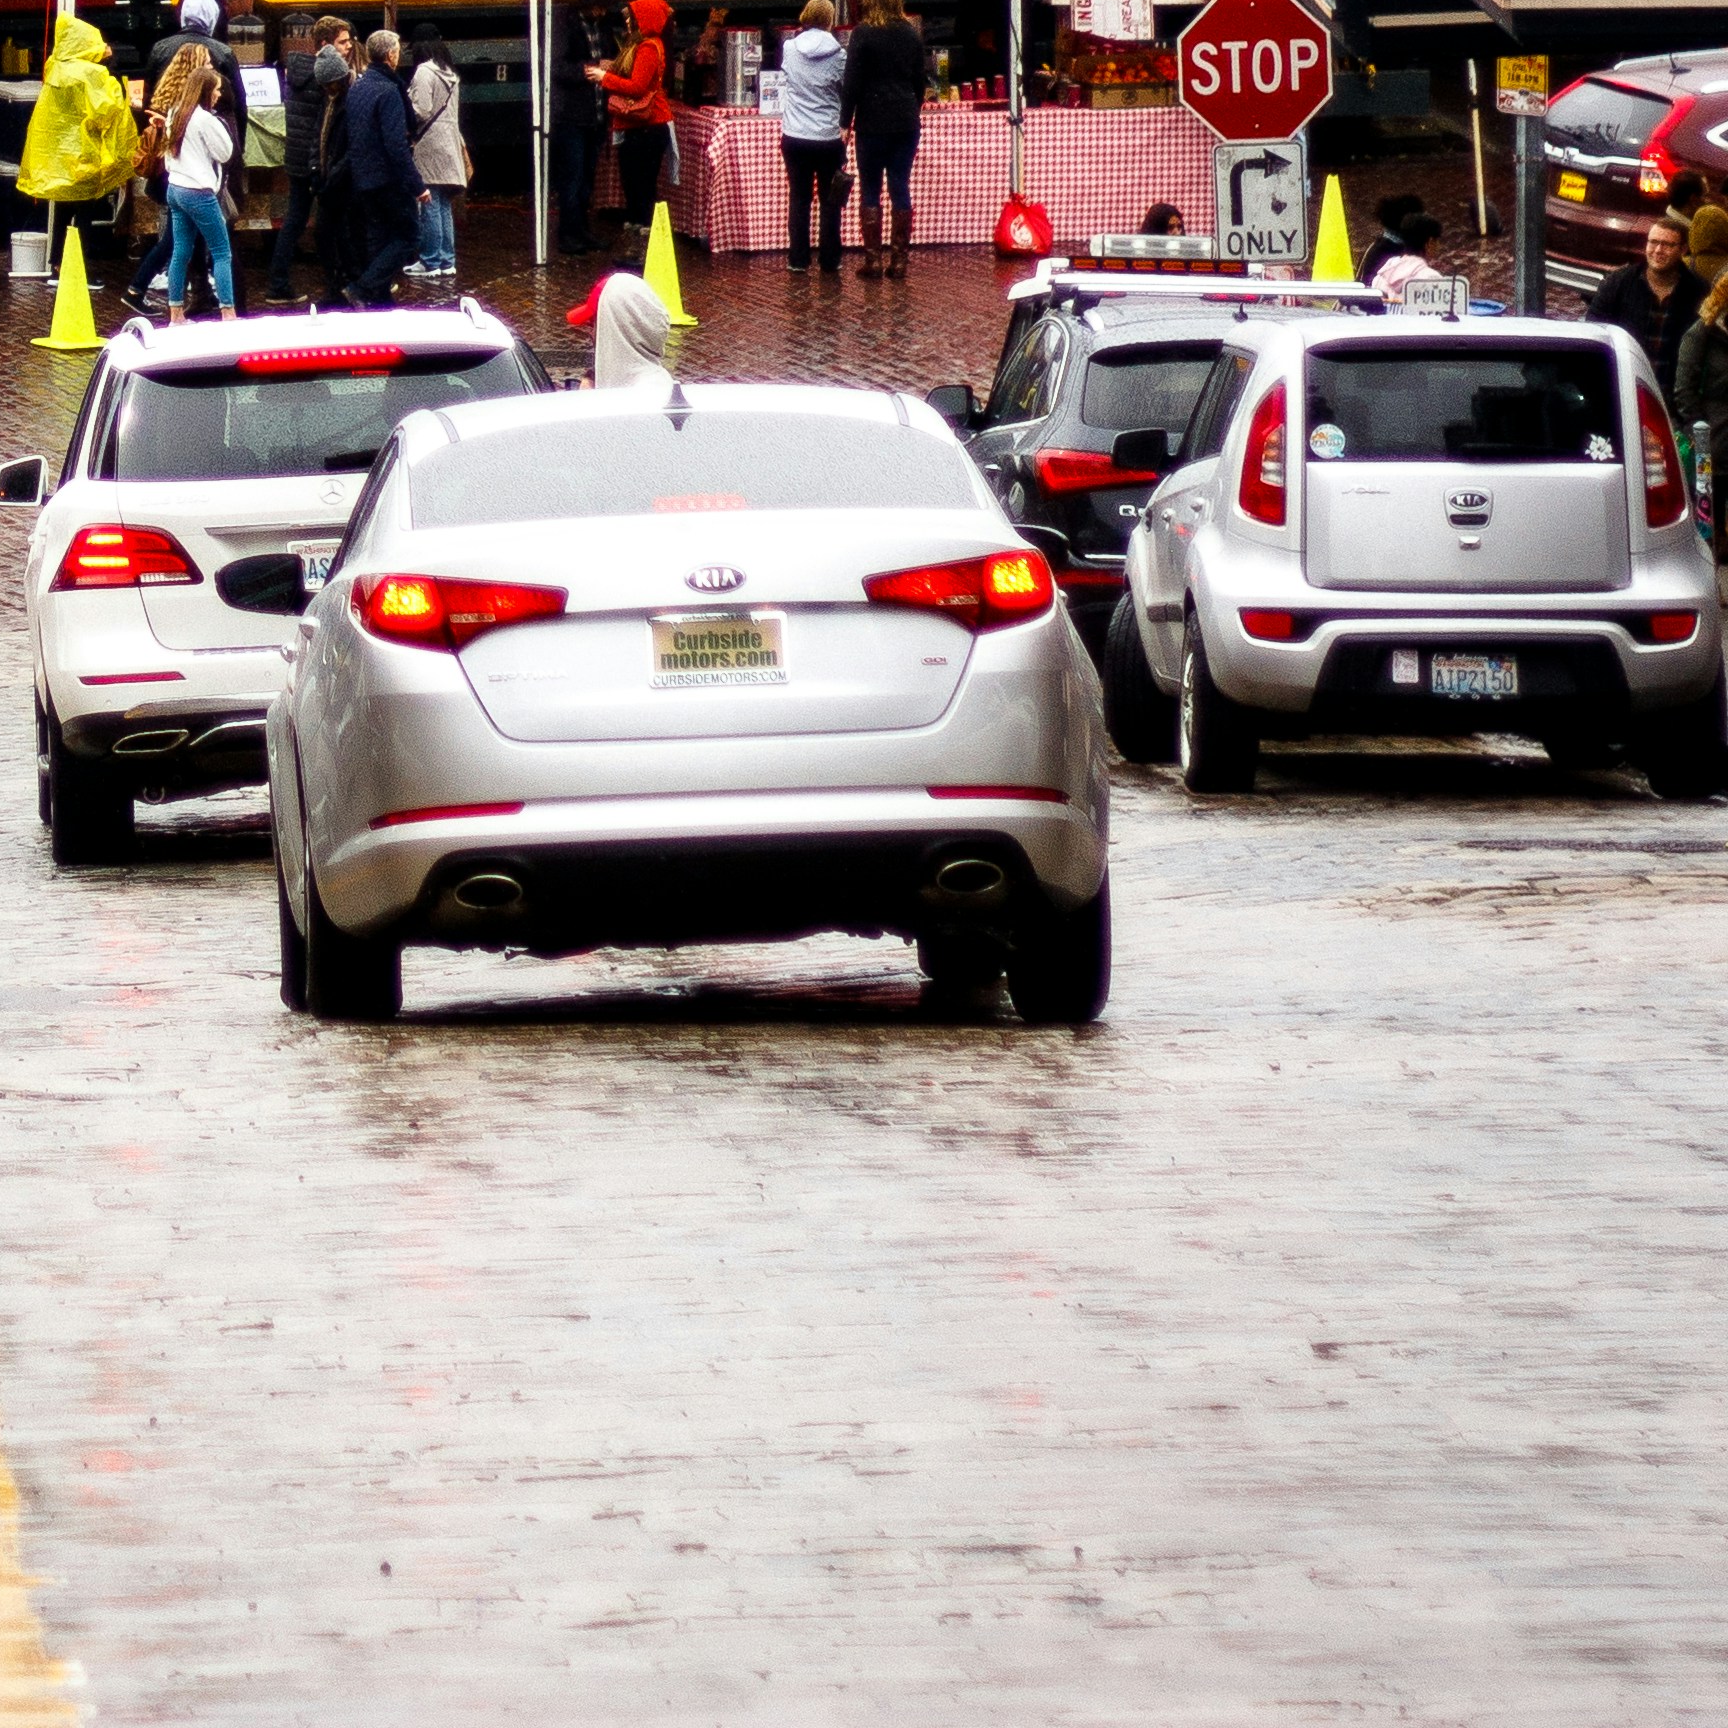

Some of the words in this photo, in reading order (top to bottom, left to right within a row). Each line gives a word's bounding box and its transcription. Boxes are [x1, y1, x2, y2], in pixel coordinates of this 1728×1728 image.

[1190, 38, 1319, 96] STOP
[248, 79, 263, 87] HOT
[1227, 229, 1298, 257] ONLY
[1413, 287, 1457, 305] POLICE
[1455, 494, 1482, 506] KIA
[693, 568, 738, 588] KIA
[673, 630, 763, 651] Curbside
[660, 649, 778, 670] motors.com
[653, 671, 788, 687] CURBSIDEMOTORS.COM
[1434, 668, 1514, 692] AIP2150
